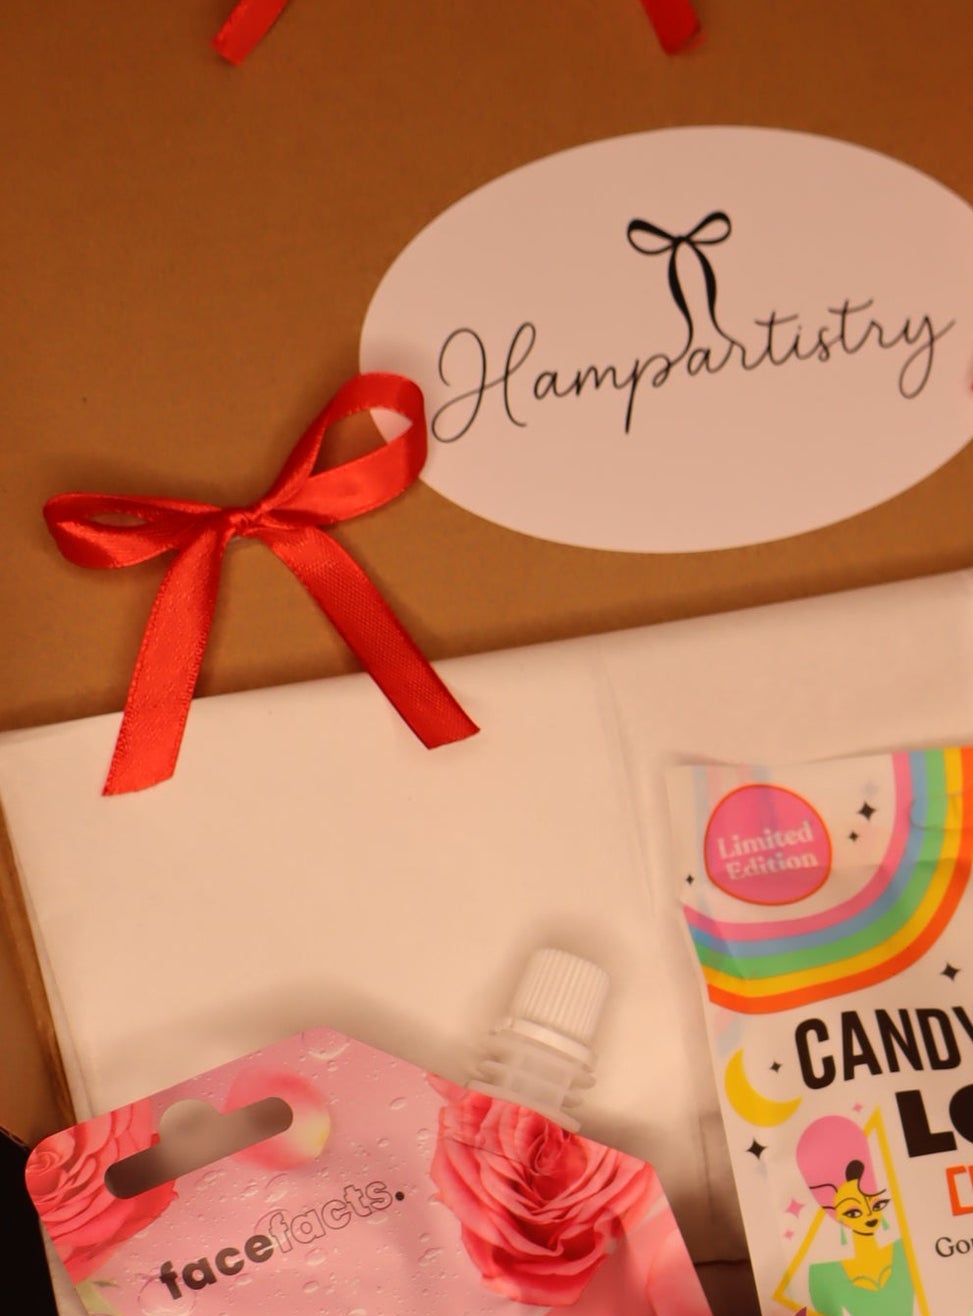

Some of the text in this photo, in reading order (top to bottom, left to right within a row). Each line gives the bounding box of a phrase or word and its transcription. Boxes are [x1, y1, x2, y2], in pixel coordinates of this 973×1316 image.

[431, 298, 955, 444] Hampartistry
[717, 820, 814, 860] Limited
[725, 851, 819, 881] Edition
